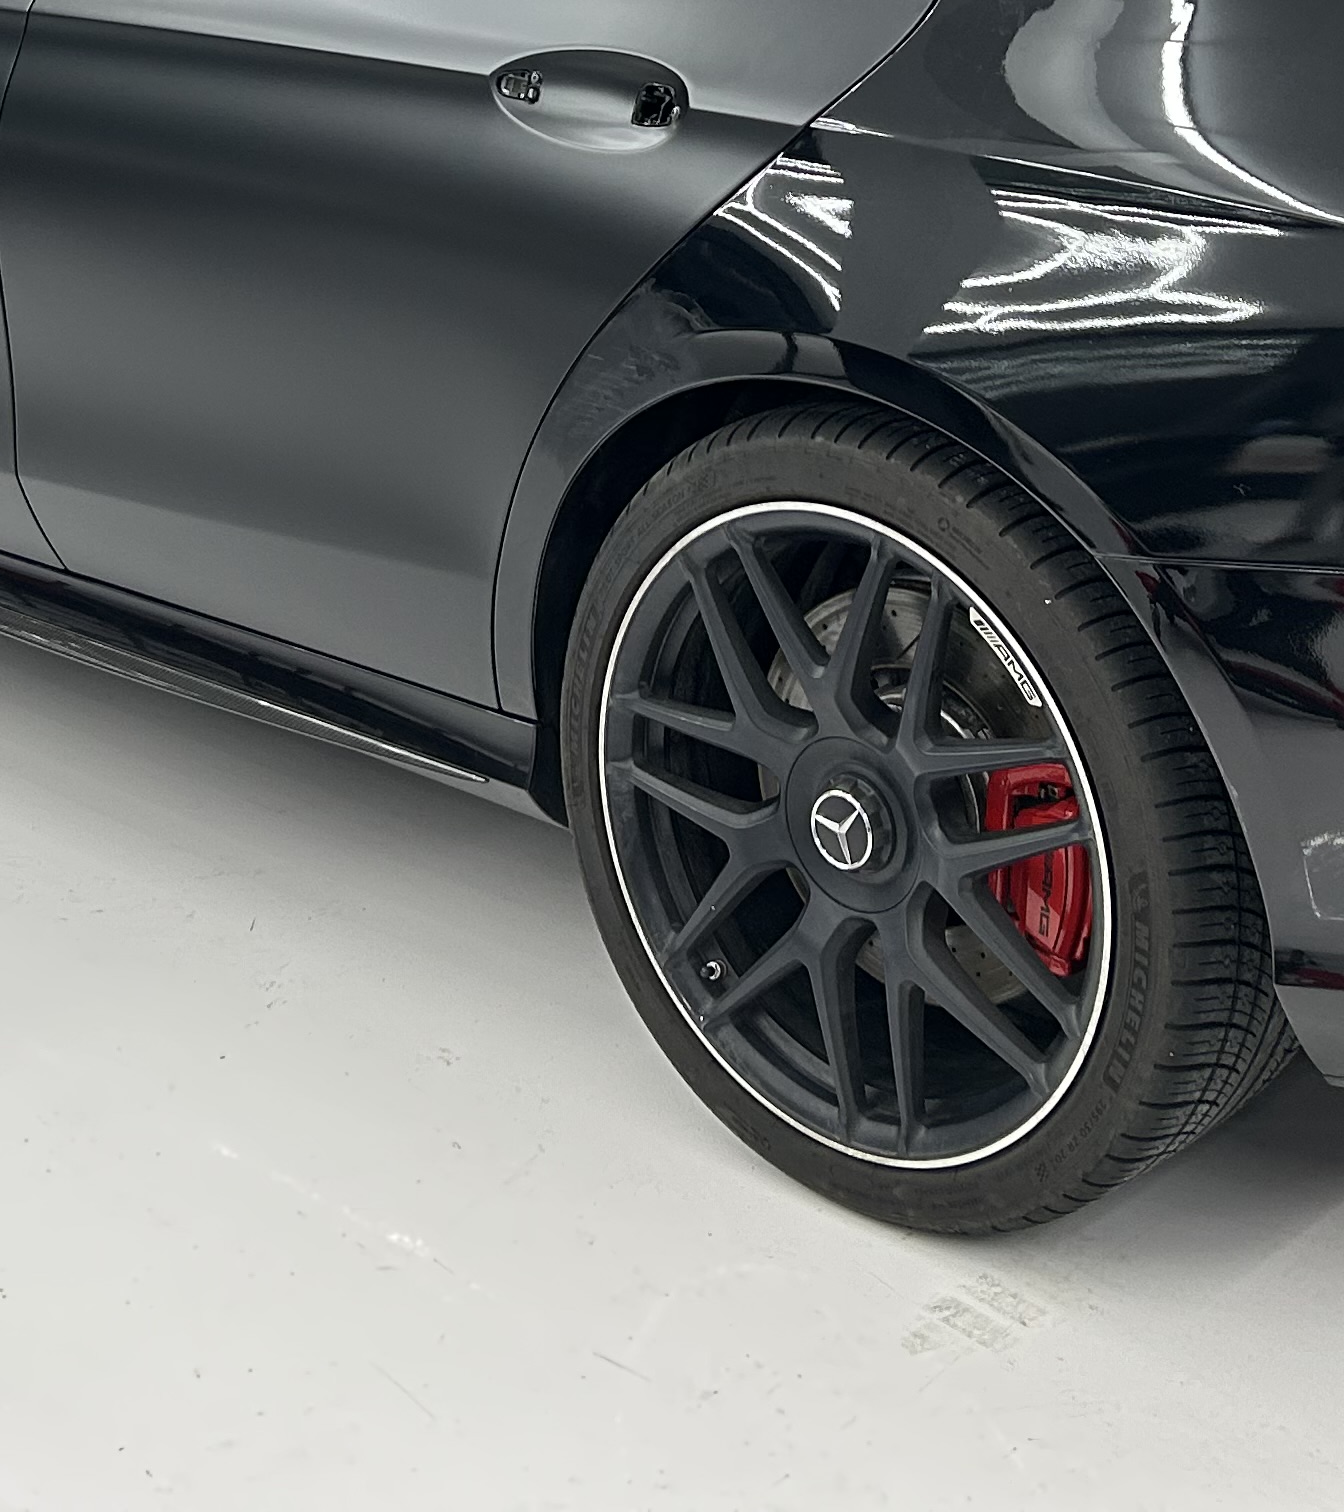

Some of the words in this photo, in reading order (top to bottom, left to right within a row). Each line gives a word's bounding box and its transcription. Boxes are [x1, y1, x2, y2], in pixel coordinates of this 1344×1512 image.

[570, 608, 597, 753] MICHELIN
[1108, 921, 1151, 1084] MICHELIN
[1080, 1098, 1106, 1138] 295/30
